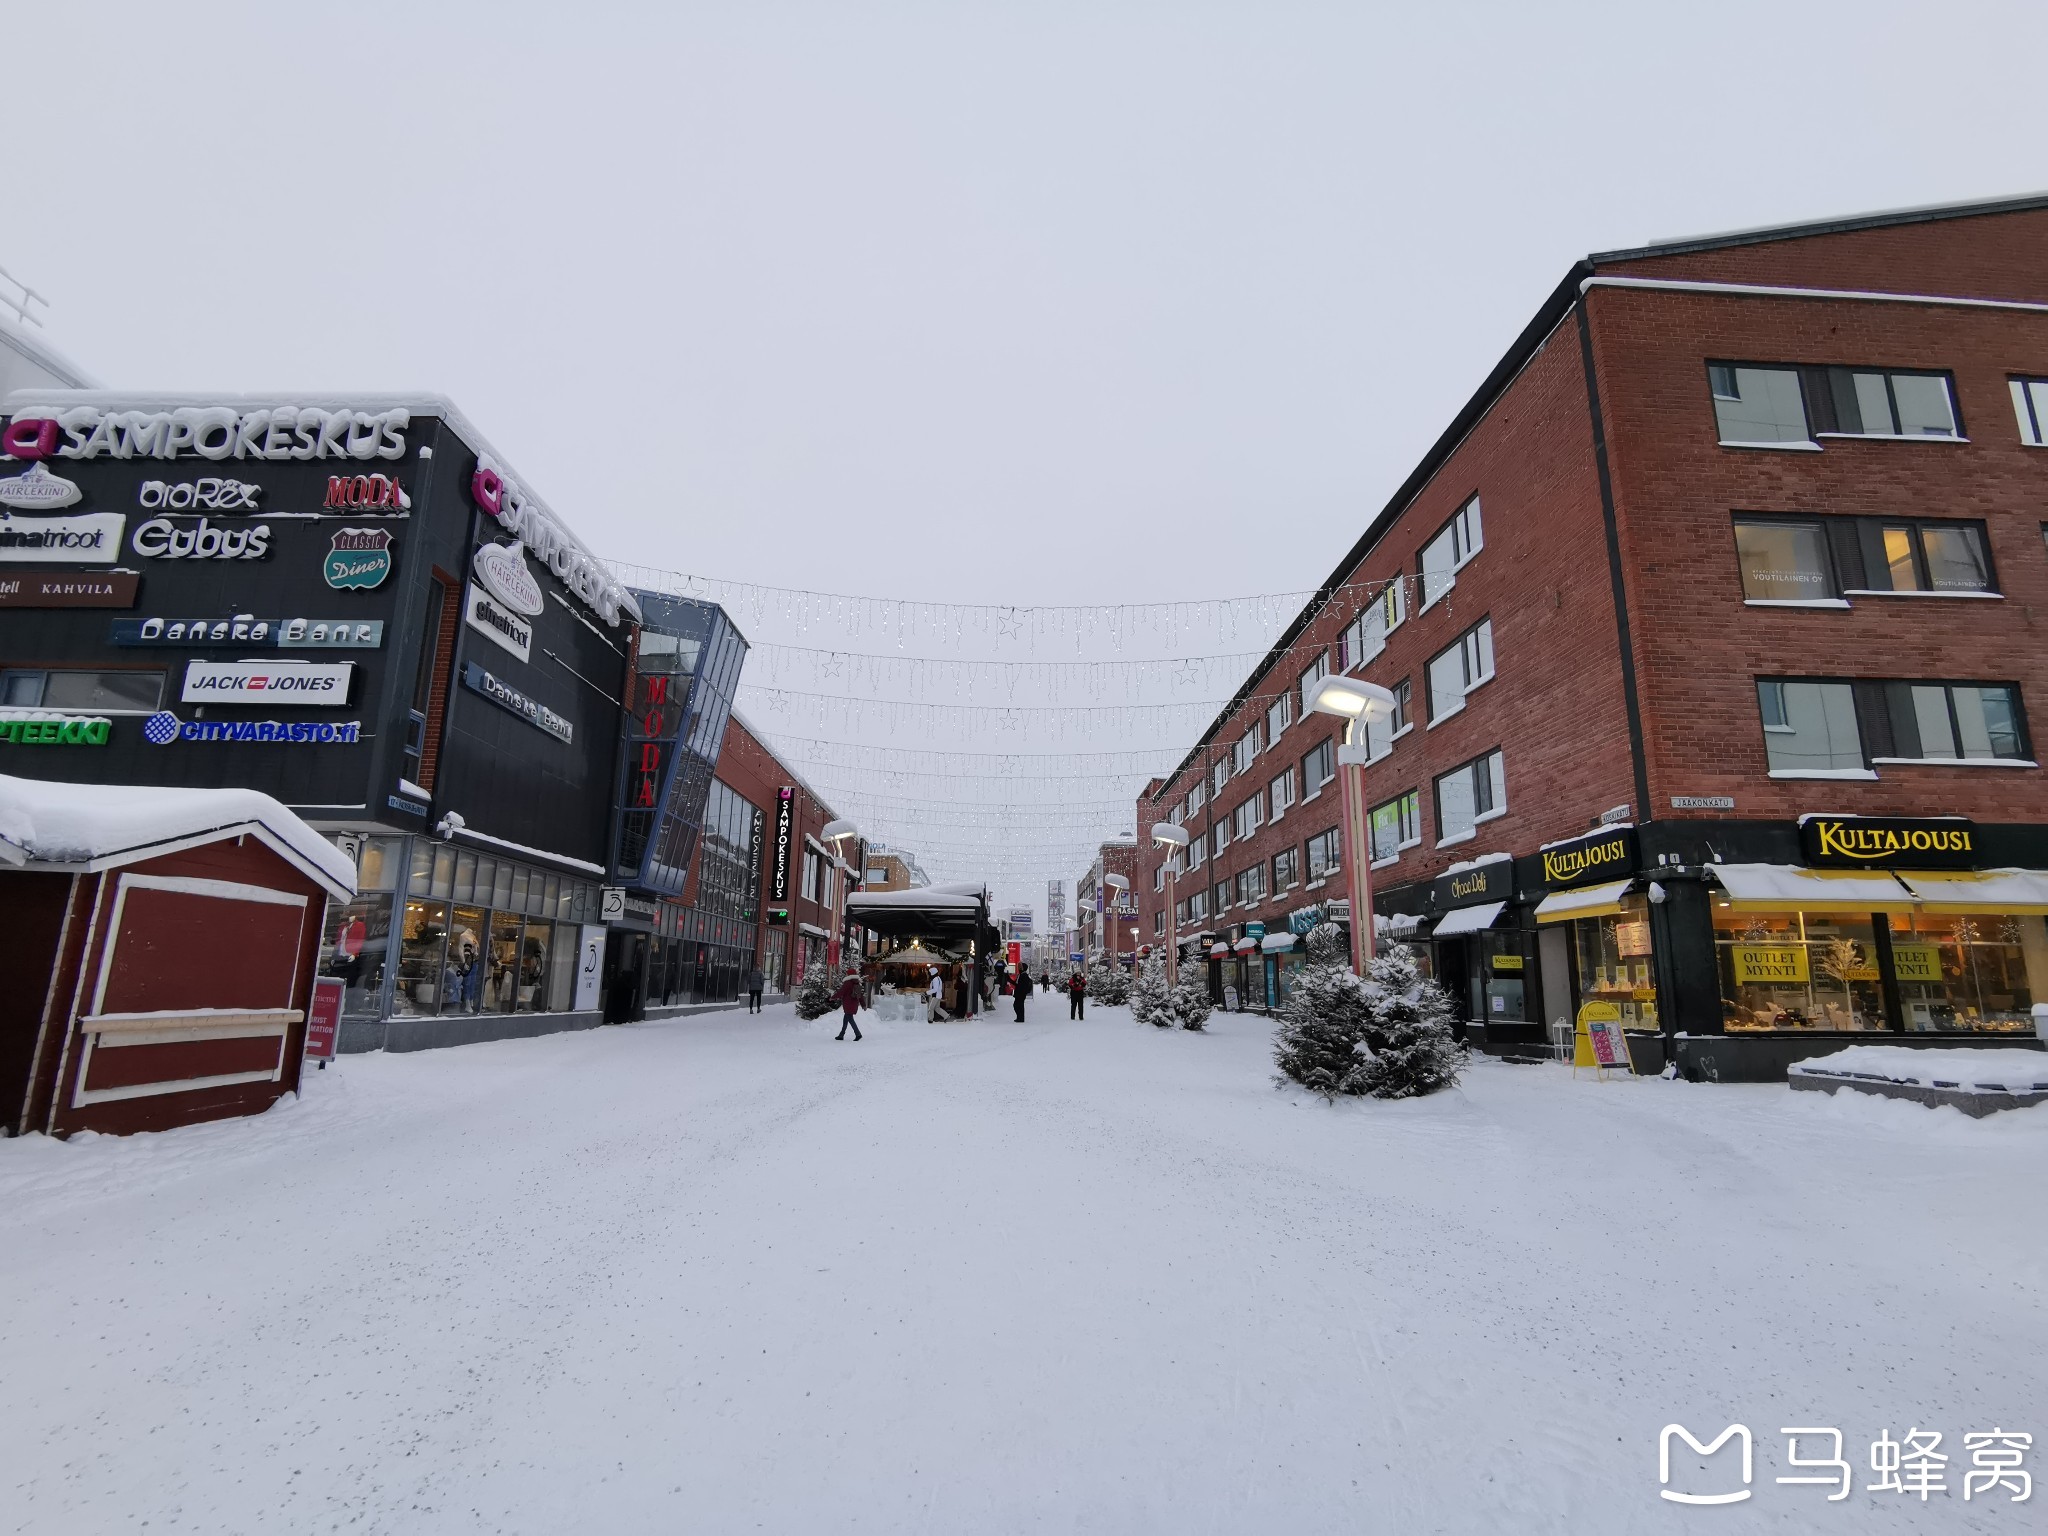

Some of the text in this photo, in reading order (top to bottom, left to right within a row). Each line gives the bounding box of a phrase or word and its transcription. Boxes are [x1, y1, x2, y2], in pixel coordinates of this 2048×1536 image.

[60, 411, 409, 461] SAMPOKESKUS
[323, 475, 401, 507] MODA
[133, 519, 270, 558] Cubus
[341, 535, 381, 549] CLASSIC
[331, 558, 386, 580] Diner
[1753, 573, 1809, 583] VOUTILAINEN
[42, 584, 113, 594] KAHVILA
[491, 561, 538, 608] HAIRLEKIINI
[140, 618, 371, 642] Danske Bank
[192, 677, 335, 690] JACK JONES
[484, 672, 537, 718] Danske
[180, 721, 359, 742] CITYVARASTO.fi
[636, 677, 667, 807] MODA
[1677, 799, 1729, 807] JAAKONKATU
[776, 801, 789, 898] SAMPOKESKUS
[1816, 822, 1973, 859] KULTAJOUSI
[1543, 840, 1626, 882] KULTAJOUSI
[1743, 953, 1796, 964] OUTLET
[1746, 965, 1797, 976] MYYNTI
